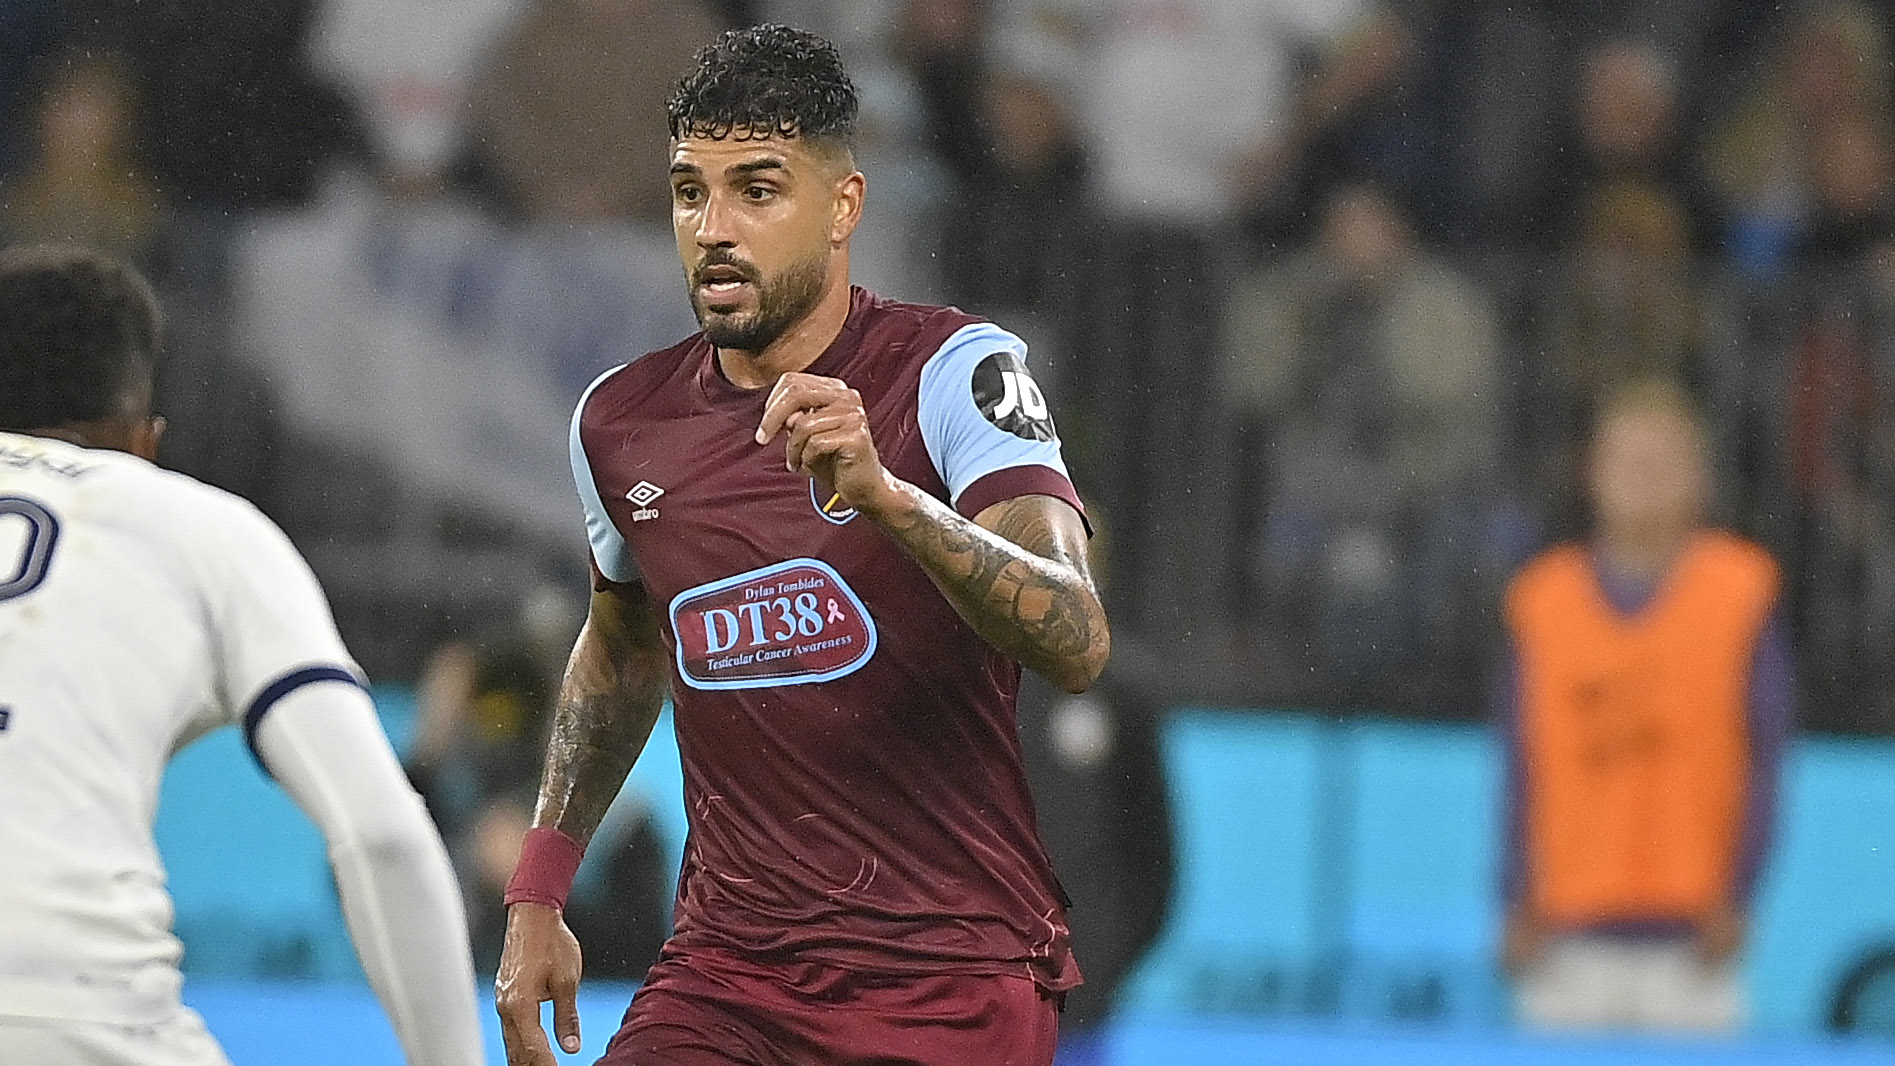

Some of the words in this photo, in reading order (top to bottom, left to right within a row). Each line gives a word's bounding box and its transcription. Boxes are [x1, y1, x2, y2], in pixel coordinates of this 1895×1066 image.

[993, 371, 1048, 420] JD
[745, 585, 775, 601] Dylan
[777, 577, 825, 594] Tombides
[699, 592, 824, 655] DT38
[707, 653, 754, 671] Testicular
[756, 646, 792, 663] Cancer
[794, 634, 853, 655] Awareness
